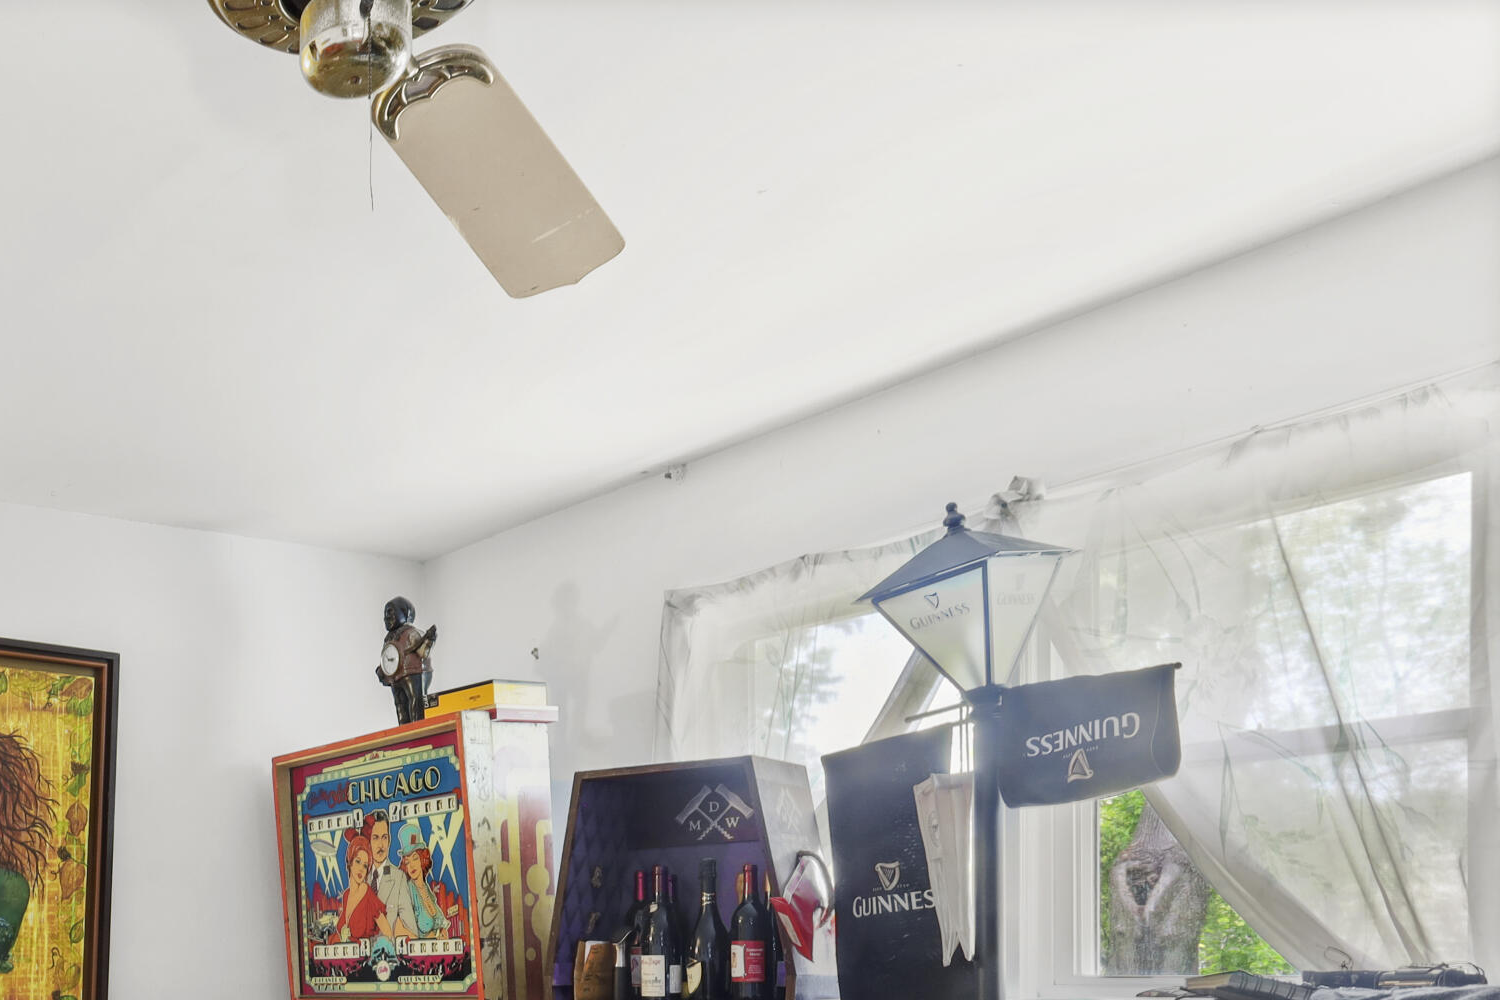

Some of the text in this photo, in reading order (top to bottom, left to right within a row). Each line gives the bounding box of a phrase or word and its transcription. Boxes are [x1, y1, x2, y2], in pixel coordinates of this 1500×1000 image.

[910, 602, 971, 630] GUINNESS
[1026, 712, 1140, 757] GUINNESS
[347, 766, 441, 806] CHICAGO
[709, 801, 720, 813] D
[689, 816, 740, 832] M W
[853, 889, 936, 918] GUINNES
